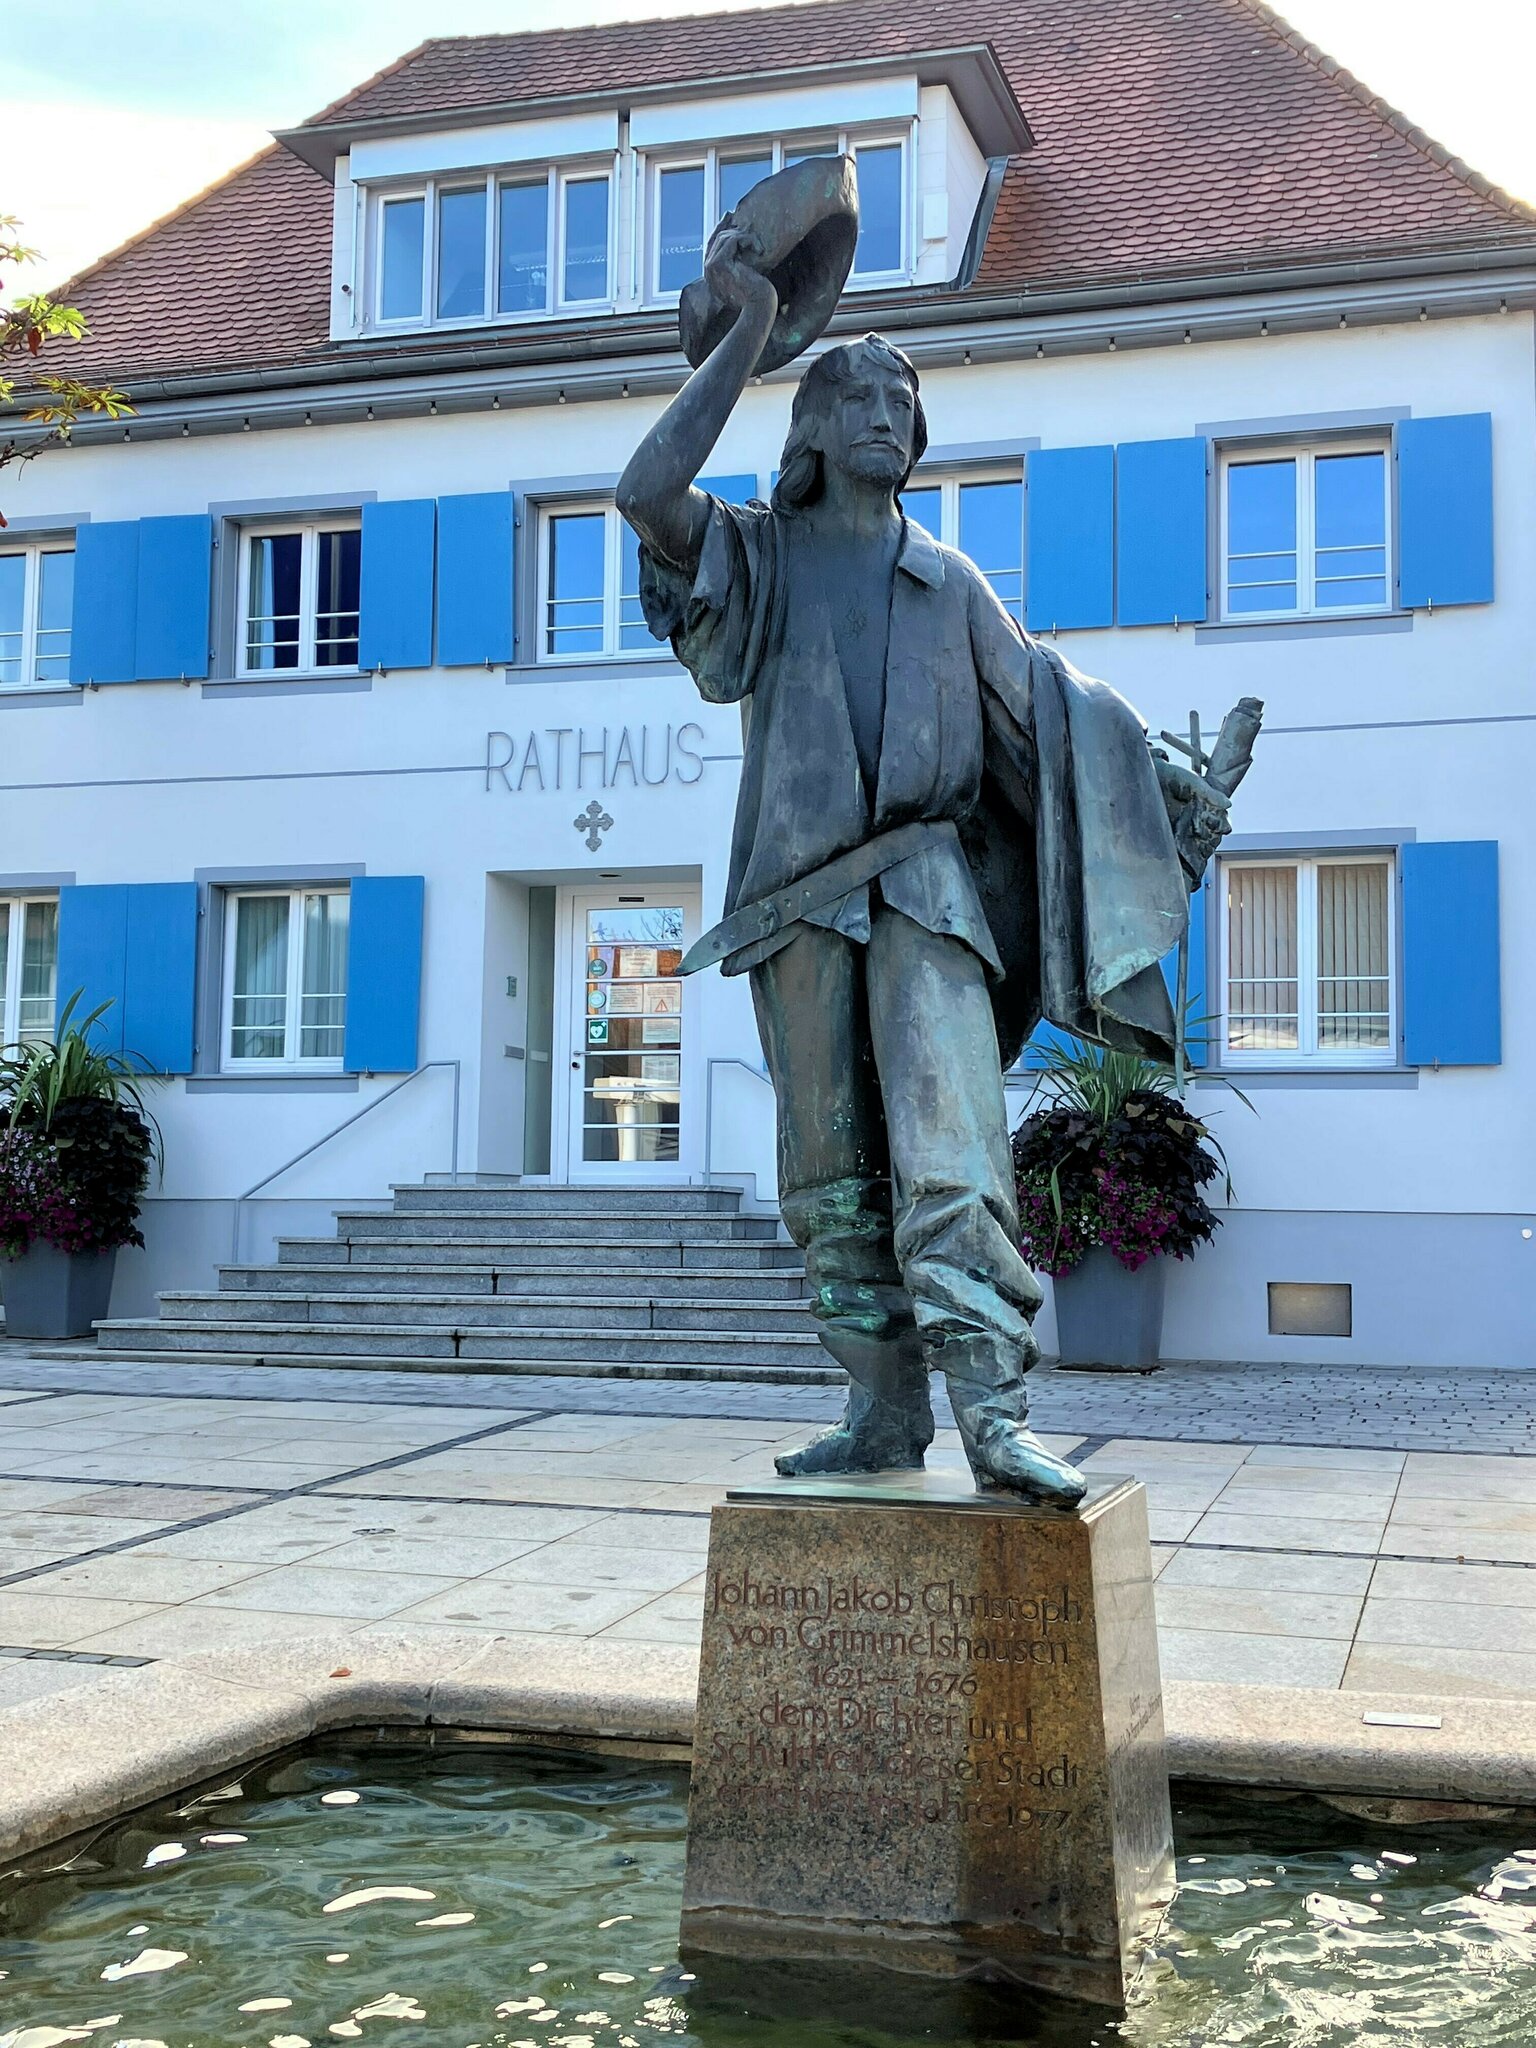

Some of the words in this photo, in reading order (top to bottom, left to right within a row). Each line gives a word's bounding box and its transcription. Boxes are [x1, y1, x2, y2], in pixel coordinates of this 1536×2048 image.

[485, 722, 704, 792] RATHAUS
[712, 1570, 820, 1617] Johann
[824, 1574, 913, 1620] Jakob
[922, 1579, 1083, 1637] Christoph
[727, 1621, 788, 1650] von
[797, 1615, 1071, 1666] Grimmelshausen
[811, 1661, 864, 1691] 1621
[915, 1670, 979, 1698] 1676
[758, 1691, 829, 1730] dem
[837, 1695, 961, 1740] Dichter
[969, 1707, 1033, 1744] und
[711, 1731, 877, 1778] Schultheiß
[884, 1742, 993, 1784] dieser
[997, 1750, 1083, 1790] Stadt
[909, 1790, 996, 1830] Jahre
[1006, 1804, 1074, 1831] 1977
